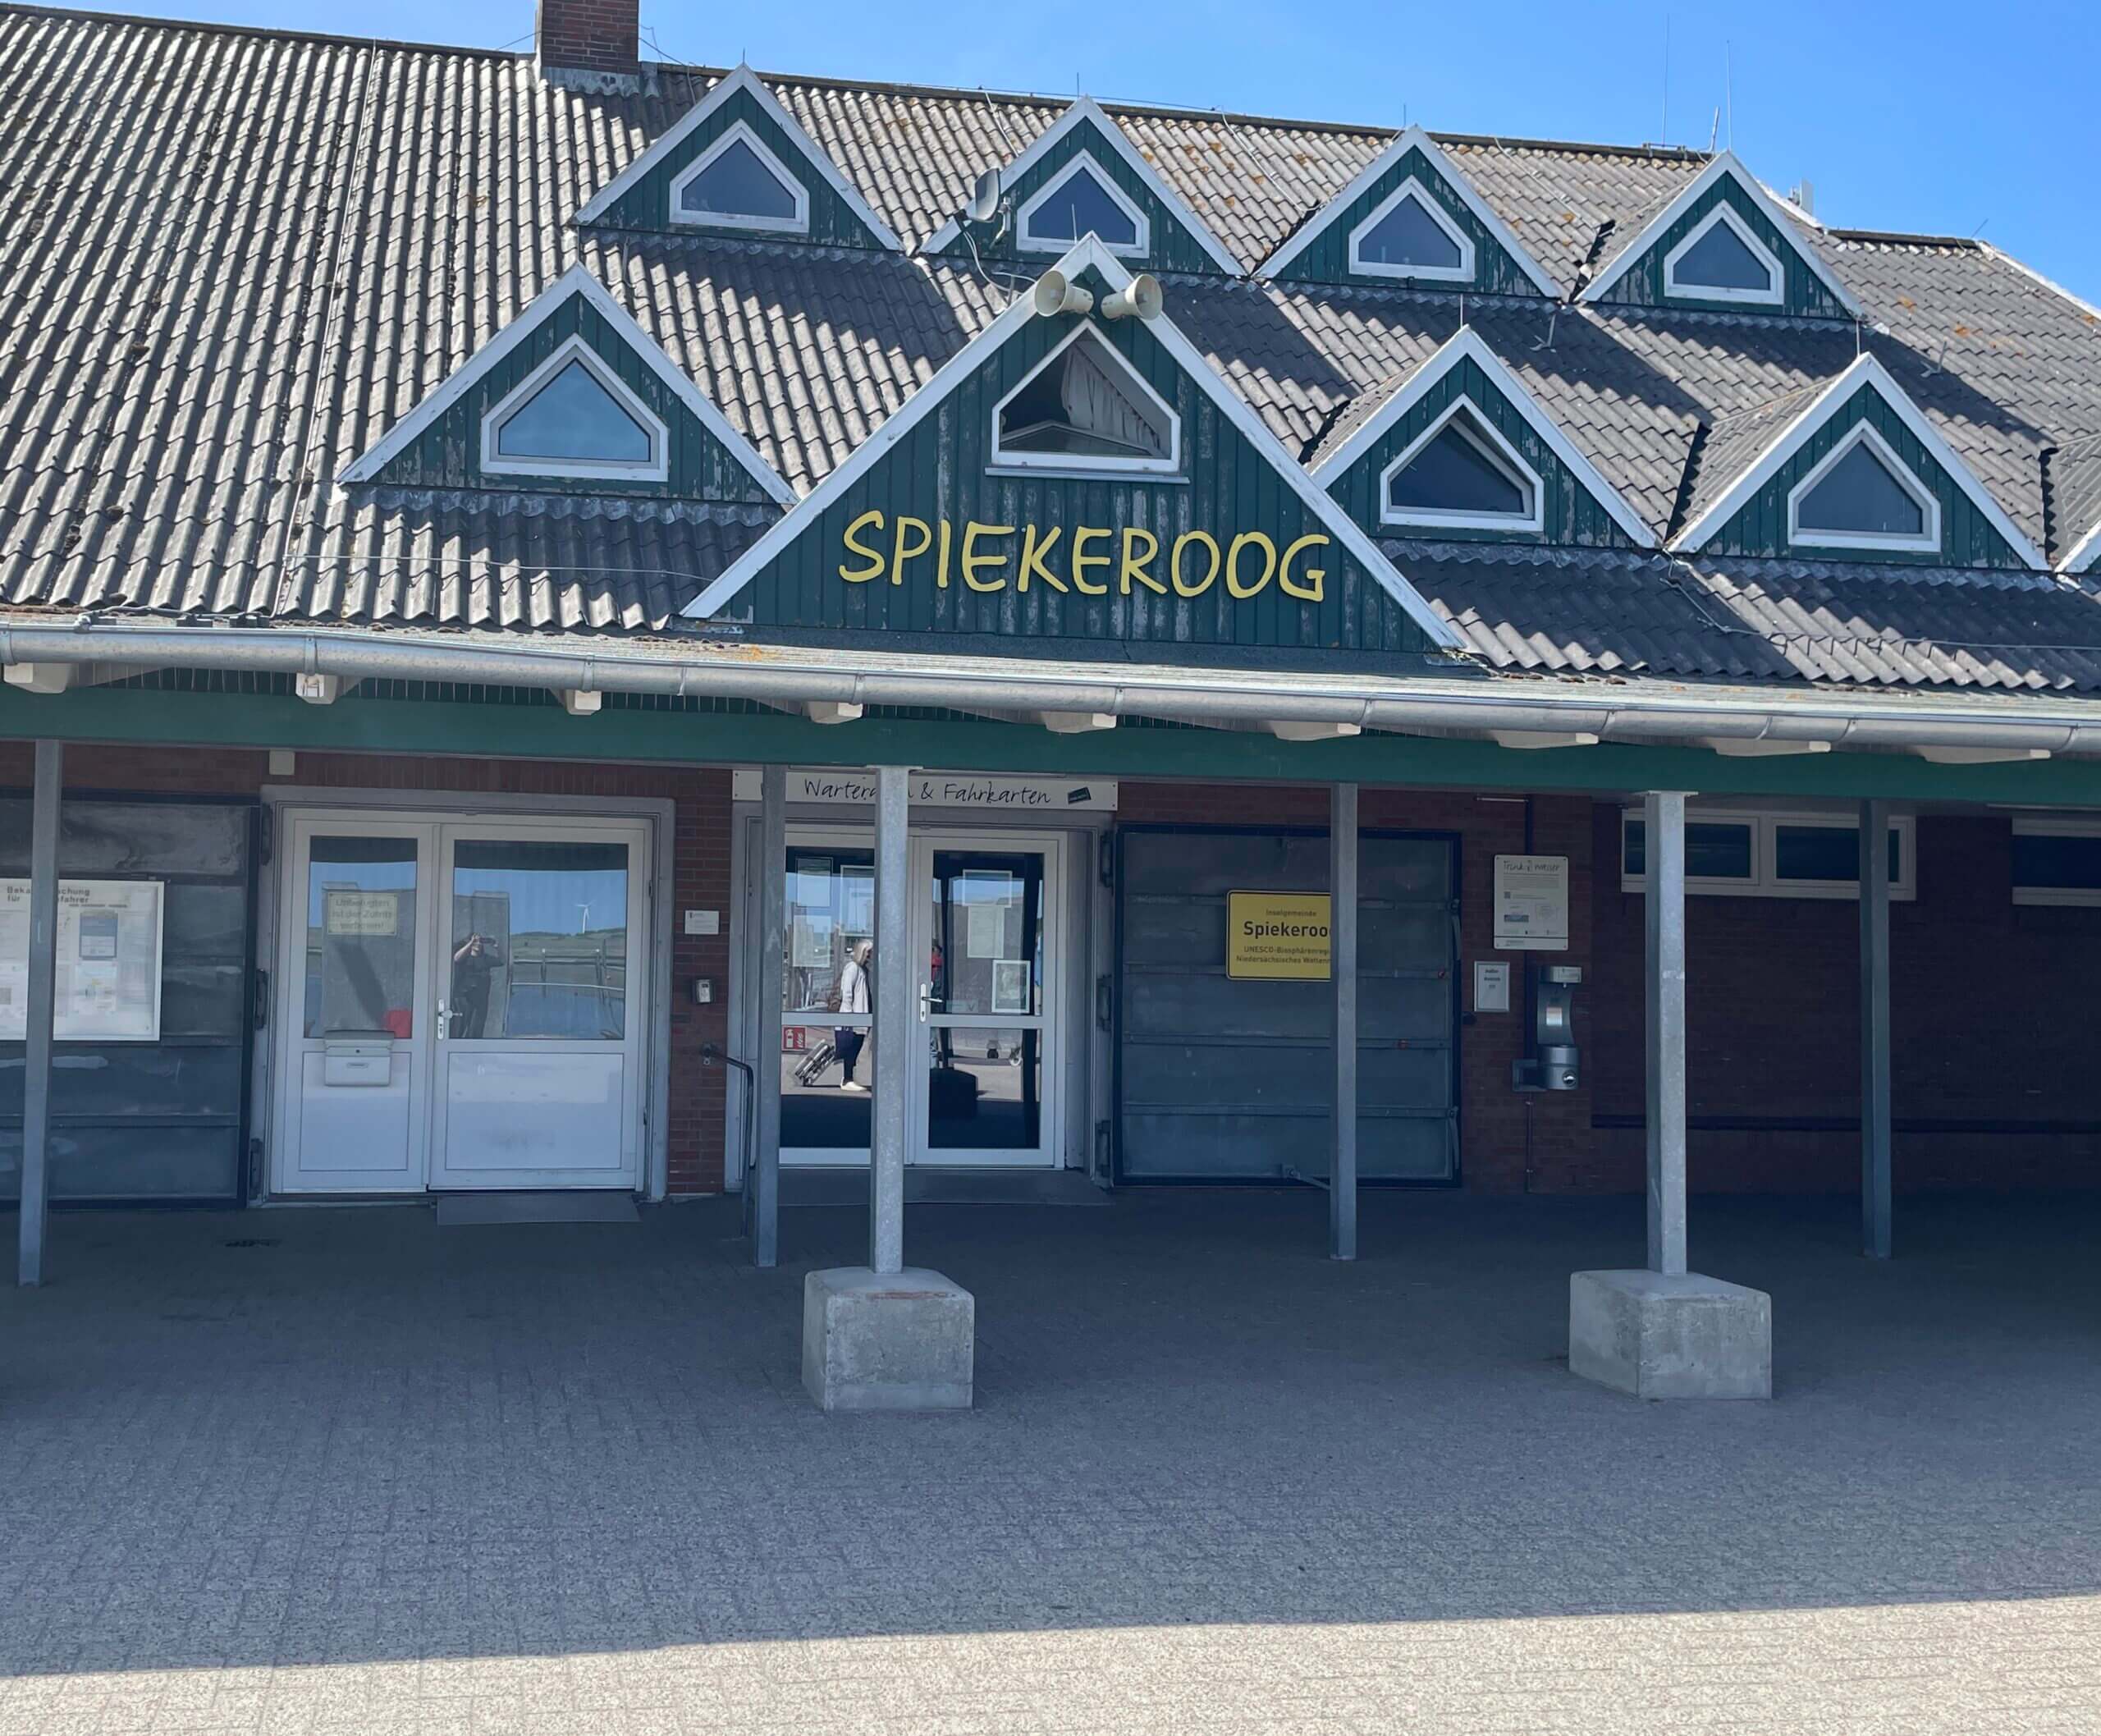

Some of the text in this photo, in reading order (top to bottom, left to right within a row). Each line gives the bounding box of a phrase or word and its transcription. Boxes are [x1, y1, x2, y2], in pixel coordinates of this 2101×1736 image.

[839, 509, 1330, 602] SPIEKEROOG
[803, 778, 1051, 804] Wartera & Fahrkarten
[1243, 921, 1330, 939] Spiekeroo
